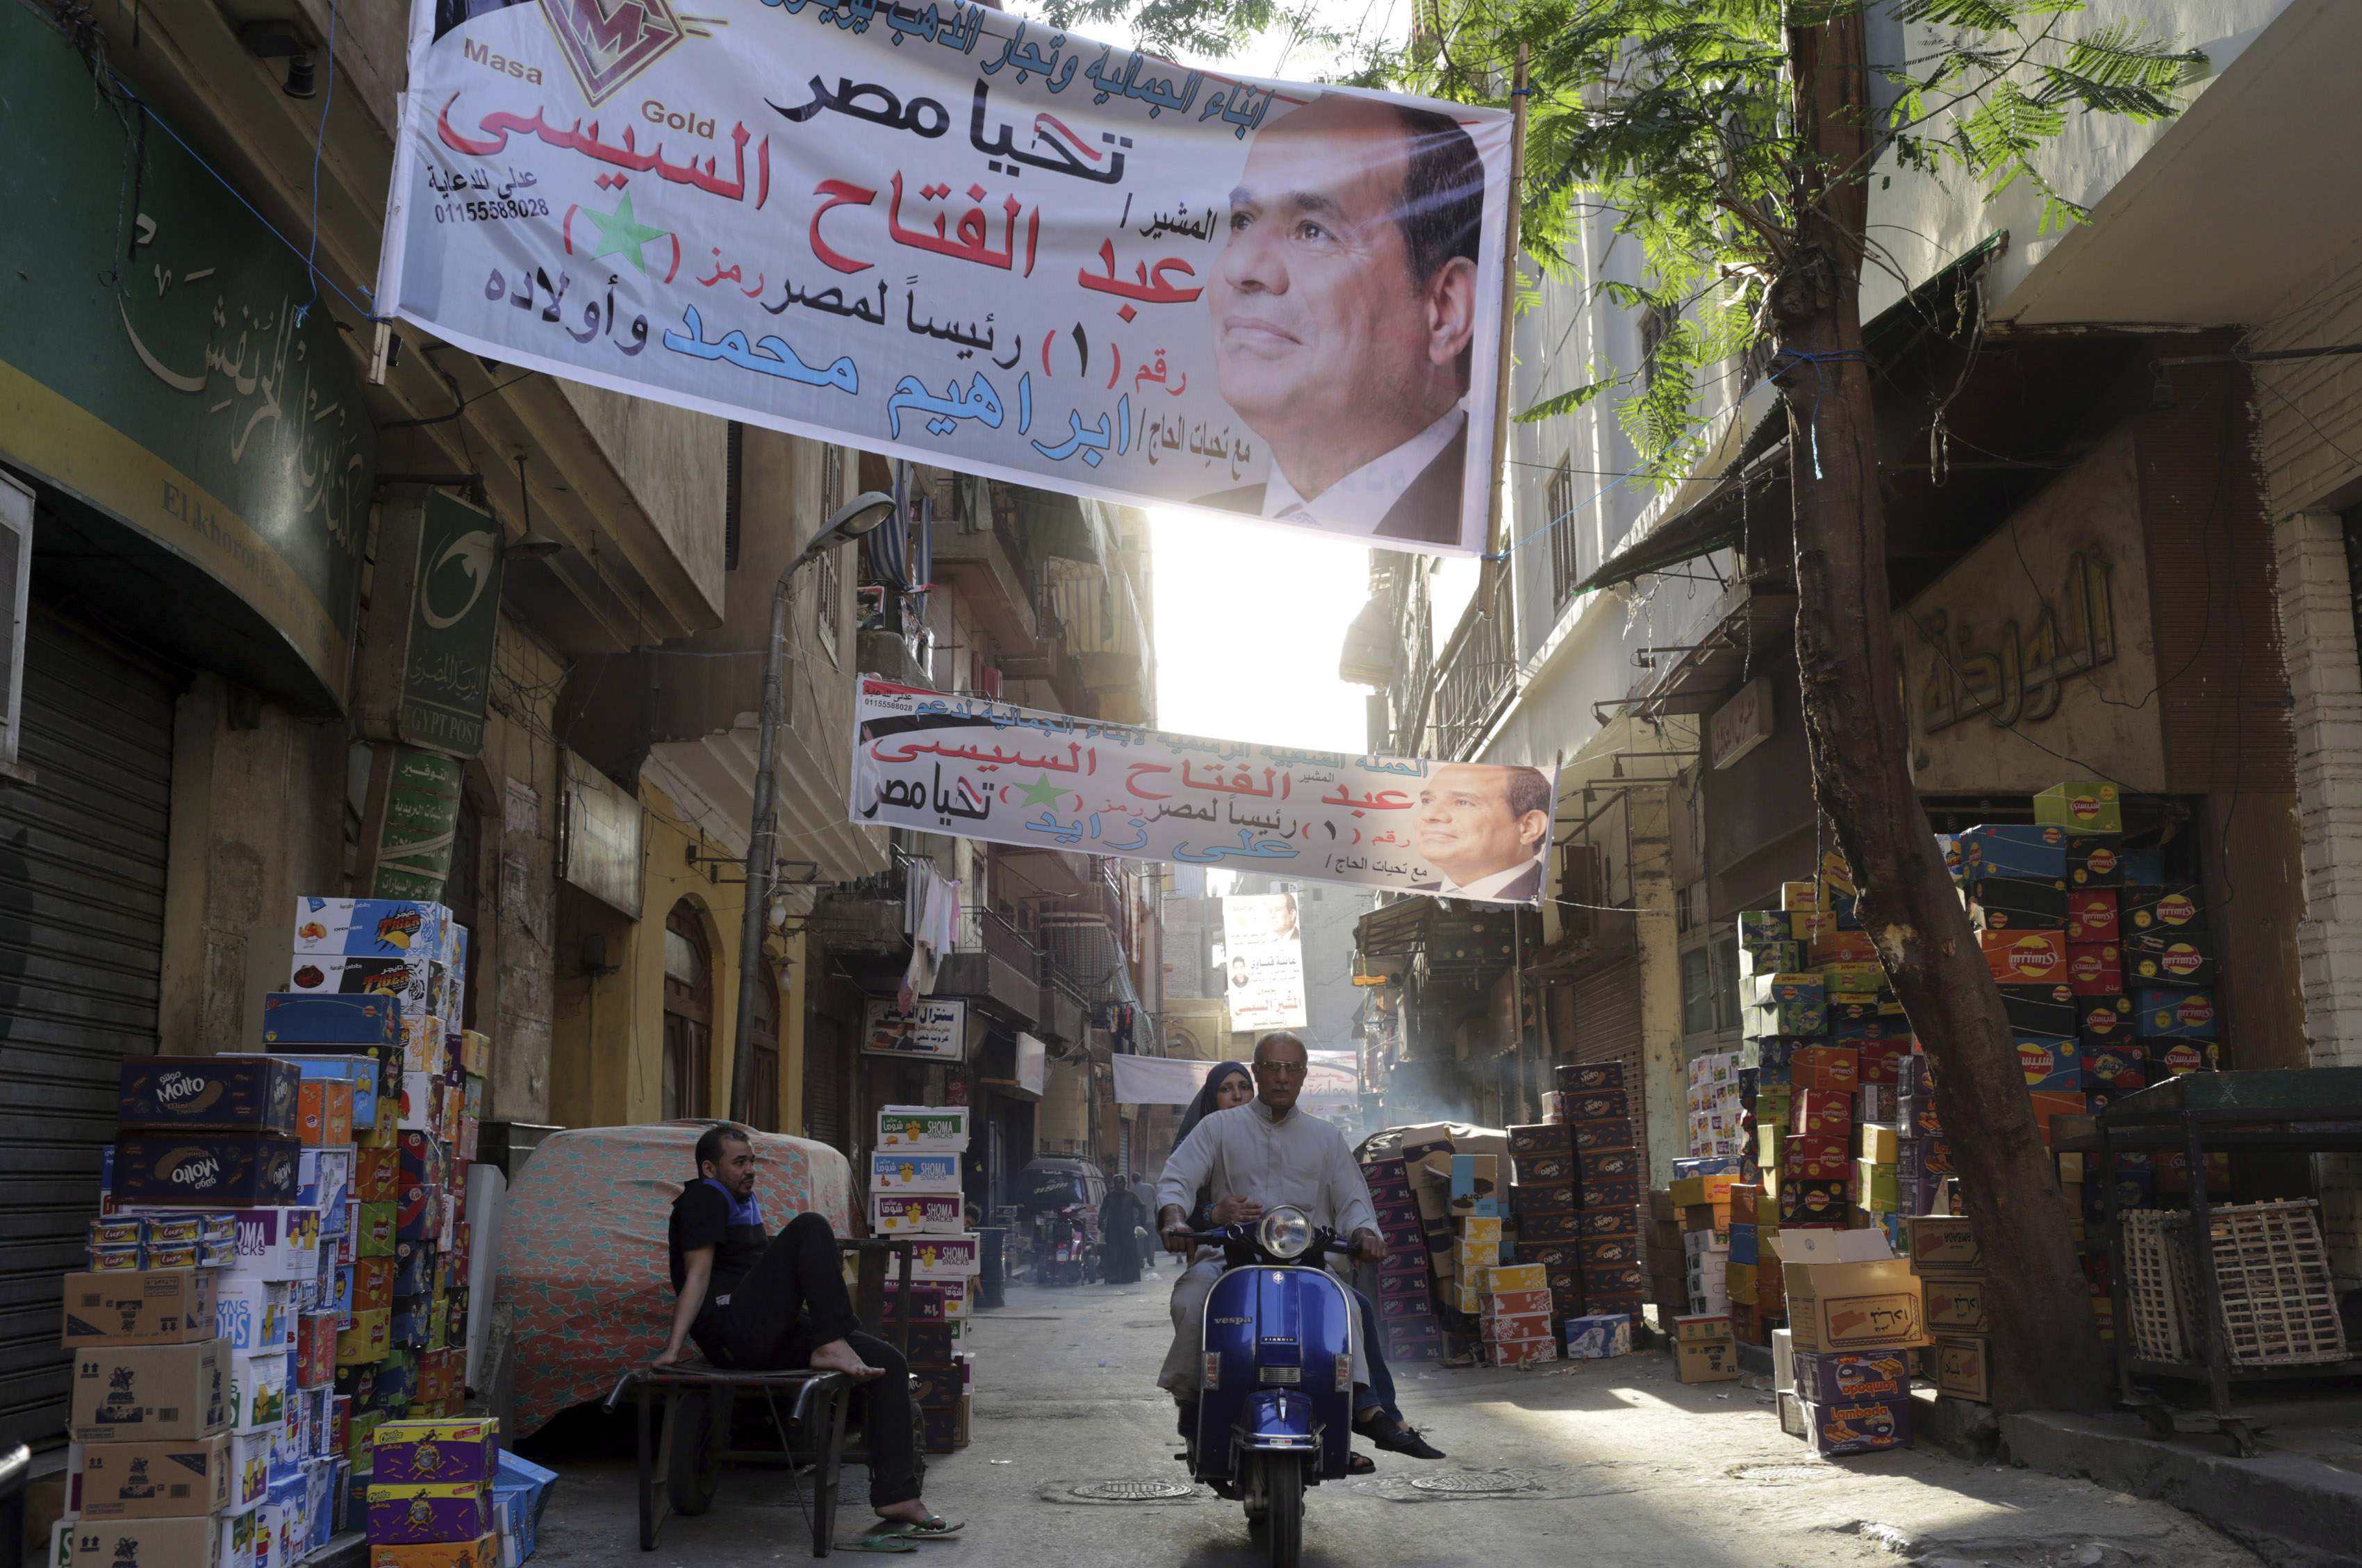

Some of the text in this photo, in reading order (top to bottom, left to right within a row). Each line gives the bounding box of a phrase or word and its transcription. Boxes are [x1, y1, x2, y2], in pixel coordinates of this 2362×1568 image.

[463, 38, 716, 140] Masa Gold
[1084, 42, 1205, 118] الجمالية
[763, 75, 1133, 184] تحيا مصر
[435, 199, 550, 224] 01155588028
[809, 169, 1039, 279] الفتاح
[1139, 201, 1217, 243] المشير
[697, 247, 764, 297] رمز
[1078, 237, 1205, 324] عبد
[761, 279, 888, 325] لمصر
[663, 304, 859, 395] محمد
[1134, 348, 1187, 396] رقم
[887, 371, 1132, 469] ابراهيم
[1148, 414, 1185, 465] الحاج
[1189, 420, 1229, 470] تحيات
[1231, 445, 1250, 481] مع
[161, 479, 188, 523] El
[864, 698, 913, 713] 01155588028
[981, 701, 1075, 738] الجمالية
[402, 704, 481, 745] EGYPT POST
[1125, 759, 1290, 801] الفتاح
[1297, 770, 1335, 785] المشير
[857, 761, 995, 827] تحيا مصر
[1098, 799, 1145, 818] رمز
[1321, 783, 1415, 818] عبد
[1143, 798, 1219, 823] لمصر
[1025, 810, 1148, 851] زايد
[1371, 829, 1411, 848] رقم
[1335, 856, 1367, 874] الحاج
[1372, 864, 1407, 878] تحيات
[1411, 866, 1428, 882] مع
[156, 1078, 206, 1104] Molto
[927, 1120, 953, 1134] SHOMA
[172, 1157, 220, 1185] Molto
[920, 1162, 947, 1175] SHOMA
[926, 1203, 953, 1217] SHOMA
[237, 1221, 265, 1246] OMA
[1944, 1232, 1975, 1244] AMBADA
[942, 1246, 970, 1260] SHOMA
[1214, 1316, 1253, 1325] vespa
[1869, 1307, 1908, 1326] لمبادا
[1841, 1380, 1899, 1400] Lambada
[1830, 1401, 1889, 1421] Lambada
